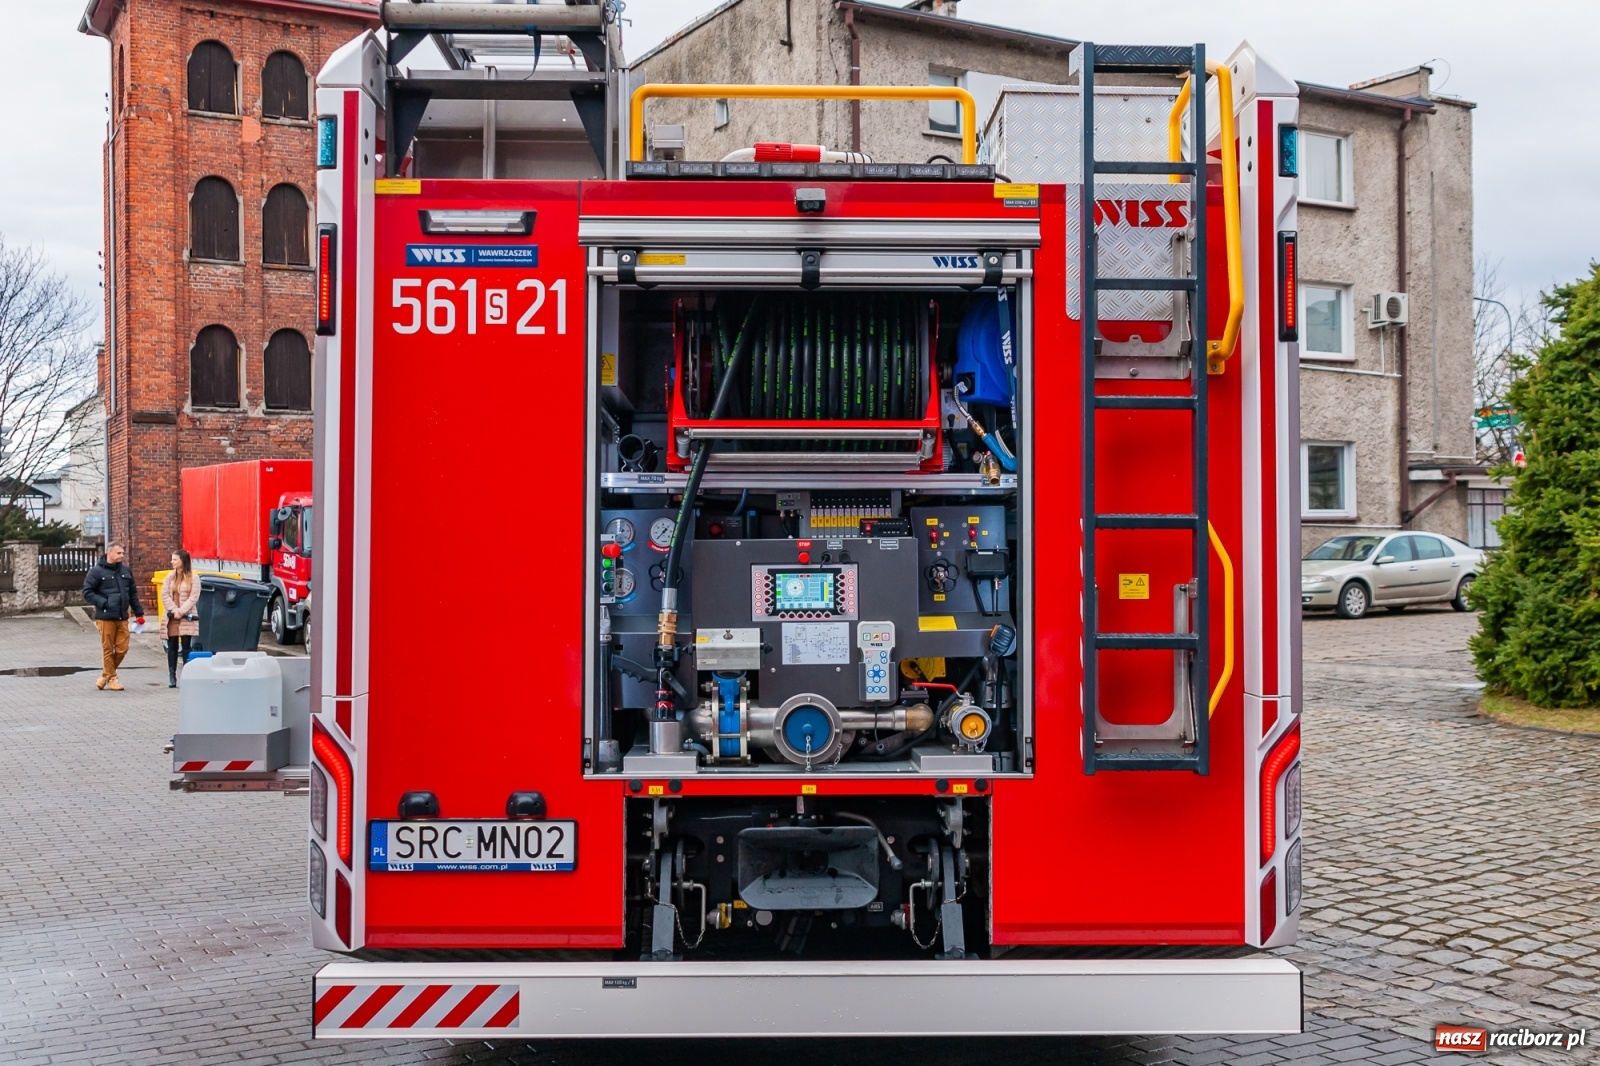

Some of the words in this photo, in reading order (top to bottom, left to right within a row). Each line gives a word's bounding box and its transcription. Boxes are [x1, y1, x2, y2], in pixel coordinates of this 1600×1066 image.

[411, 248, 466, 263] WISS
[932, 256, 978, 268] WISS
[392, 278, 477, 335] 561
[516, 278, 567, 335] 21
[1002, 330, 1012, 364] WISS
[373, 848, 385, 856] PL
[396, 826, 462, 858] SRC
[477, 826, 564, 858] MN02
